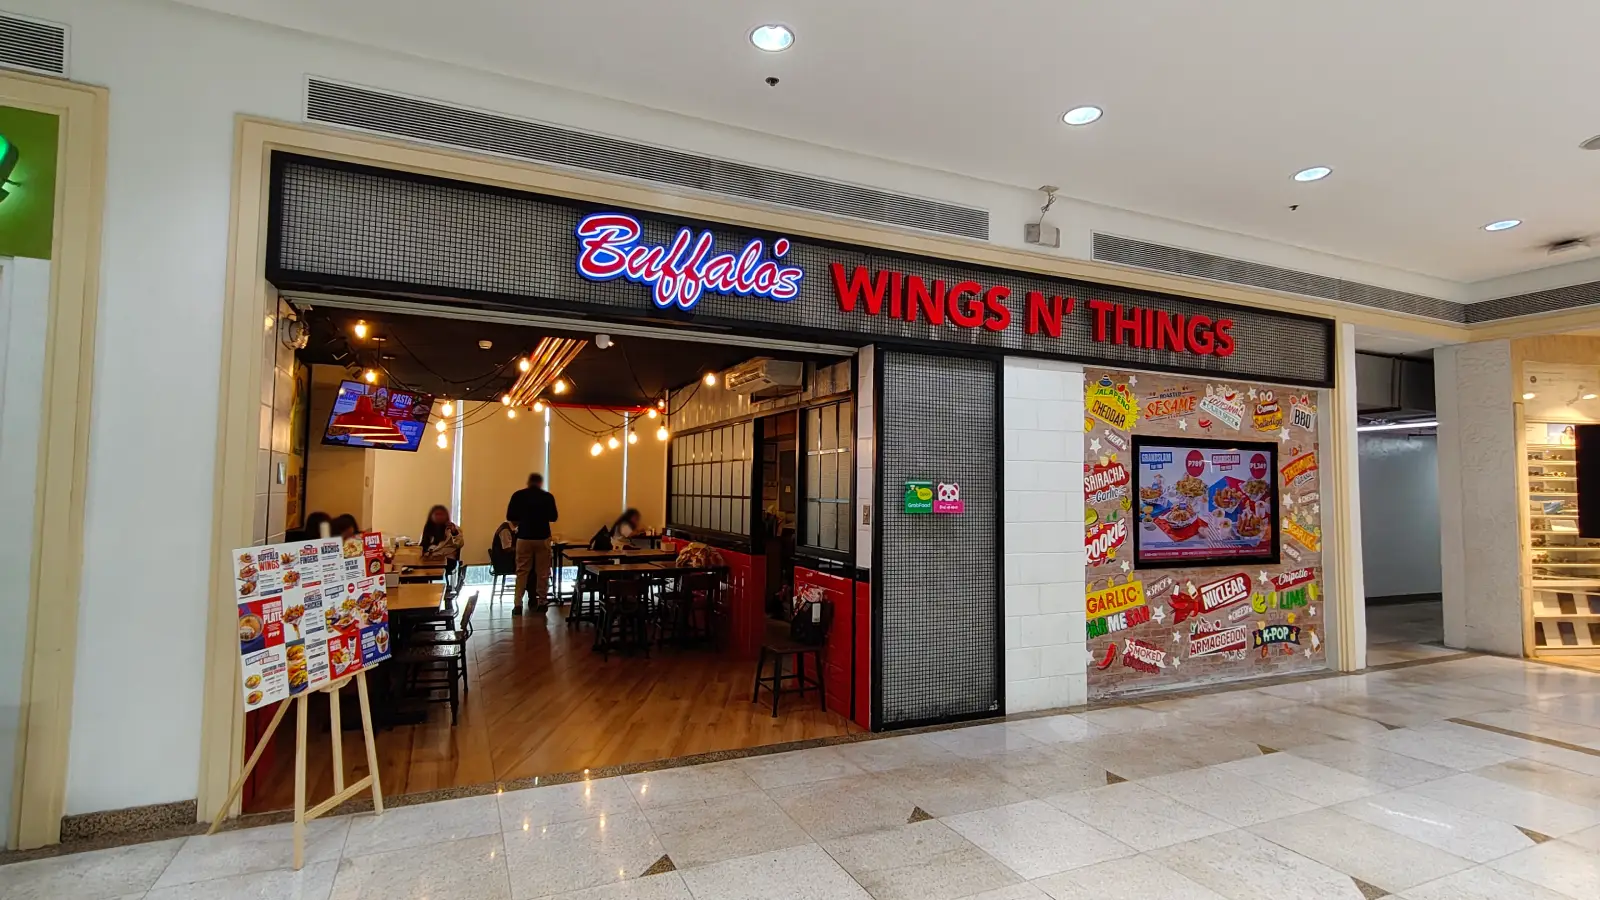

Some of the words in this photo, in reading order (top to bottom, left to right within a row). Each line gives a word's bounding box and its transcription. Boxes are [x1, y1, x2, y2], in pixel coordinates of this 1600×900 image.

[576, 213, 803, 309] Buffalo's
[829, 262, 1011, 332] WINGS
[1023, 290, 1075, 339] N'
[1089, 299, 1236, 358] THINGS
[391, 393, 412, 405] PASTA
[1094, 388, 1131, 411] JALAPEÑO
[1145, 396, 1198, 420] SESAME
[1092, 399, 1126, 429] CHEDDAR
[1294, 409, 1312, 429] BBQ
[1108, 431, 1124, 446] HEAT
[1141, 453, 1172, 463] GRANDSLAM
[1084, 465, 1126, 493] SRIRACHA
[1096, 485, 1119, 502] Garlic
[1090, 525, 1099, 535] THE
[258, 552, 279, 562] BUFFALO
[258, 560, 280, 572] WINGS
[299, 555, 318, 564] FINGERS
[1150, 578, 1167, 595] SPICY
[1278, 568, 1308, 586] Chipotle
[1086, 586, 1137, 614] GARLIC
[1202, 576, 1247, 611] NUCLEAR
[1280, 587, 1308, 610] LIME
[263, 610, 283, 624] PLATE
[1086, 605, 1151, 640] PARMESAN
[1189, 627, 1247, 656] ARMAGGEDON
[1262, 626, 1289, 643] K-POP
[1128, 642, 1162, 663] SMOKED
